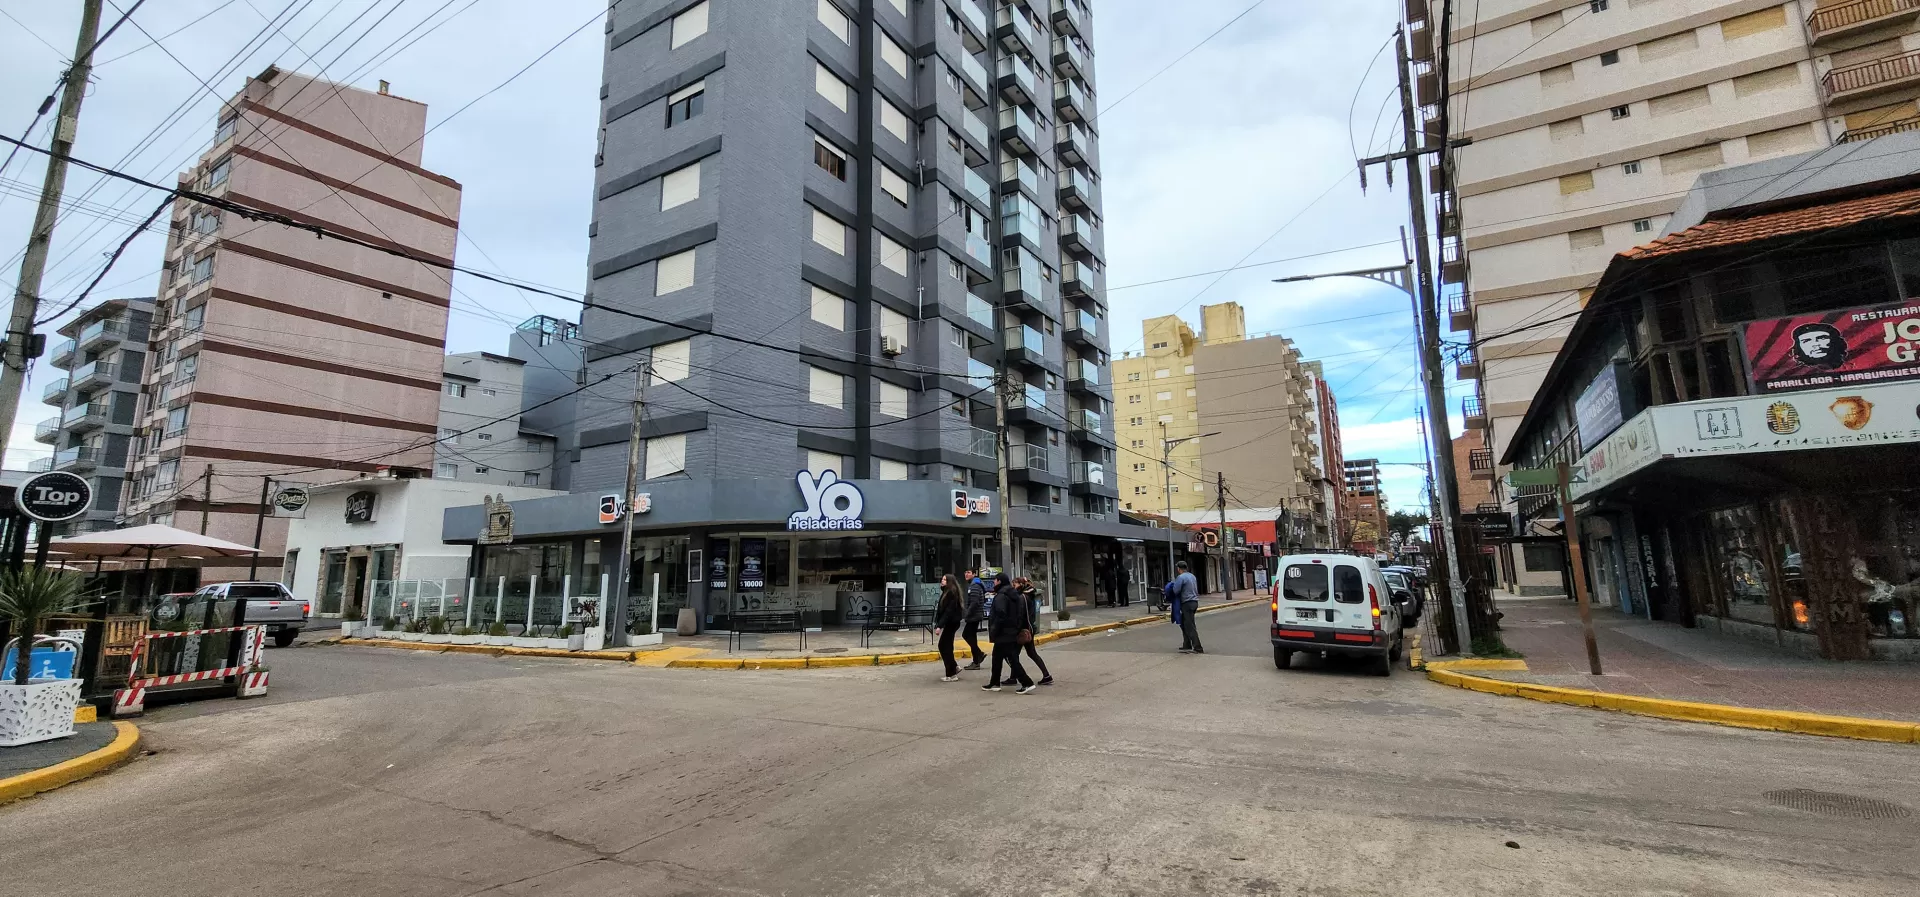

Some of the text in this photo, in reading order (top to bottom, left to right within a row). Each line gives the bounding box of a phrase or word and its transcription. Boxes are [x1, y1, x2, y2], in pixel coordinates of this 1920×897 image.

[1851, 305, 1920, 322] RESTAURA
[35, 486, 80, 506] Top
[788, 516, 862, 529] Heladerías
[1287, 567, 1301, 578] 110
